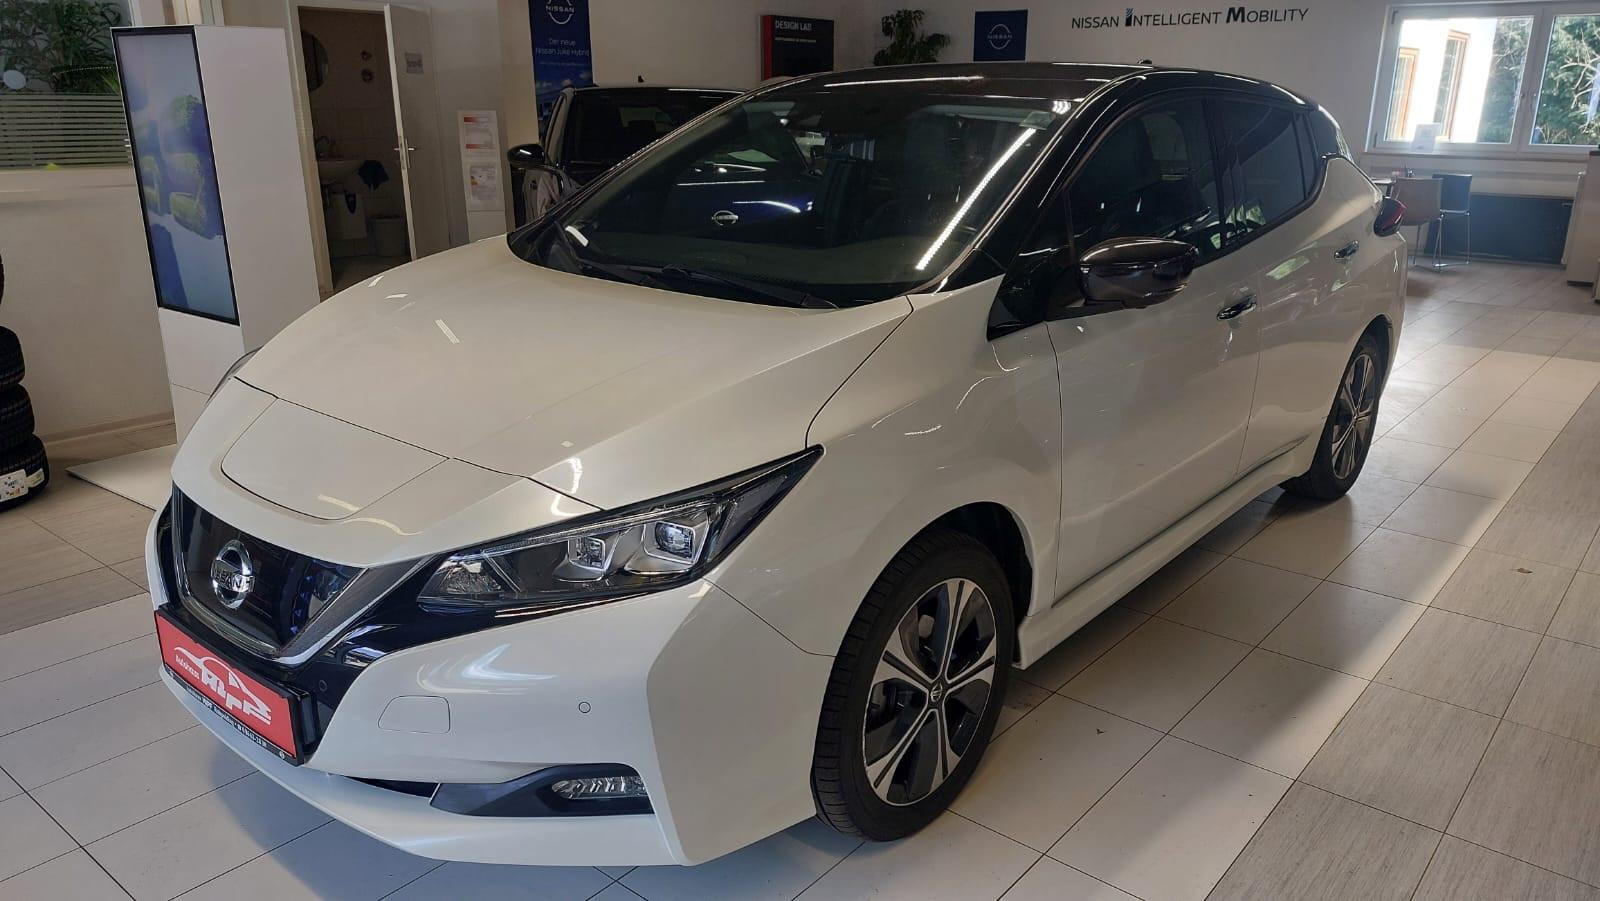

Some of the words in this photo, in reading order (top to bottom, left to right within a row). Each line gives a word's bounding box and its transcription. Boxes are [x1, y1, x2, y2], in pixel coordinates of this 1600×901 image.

[546, 5, 574, 13] NISSAN
[1071, 16, 1119, 29] NISSAN
[1124, 8, 1222, 27] INTELLIGENT
[1226, 6, 1309, 24] MOBILITY
[775, 20, 799, 30] DESIGN
[800, 22, 812, 31] LAB
[536, 47, 556, 55] Nissan
